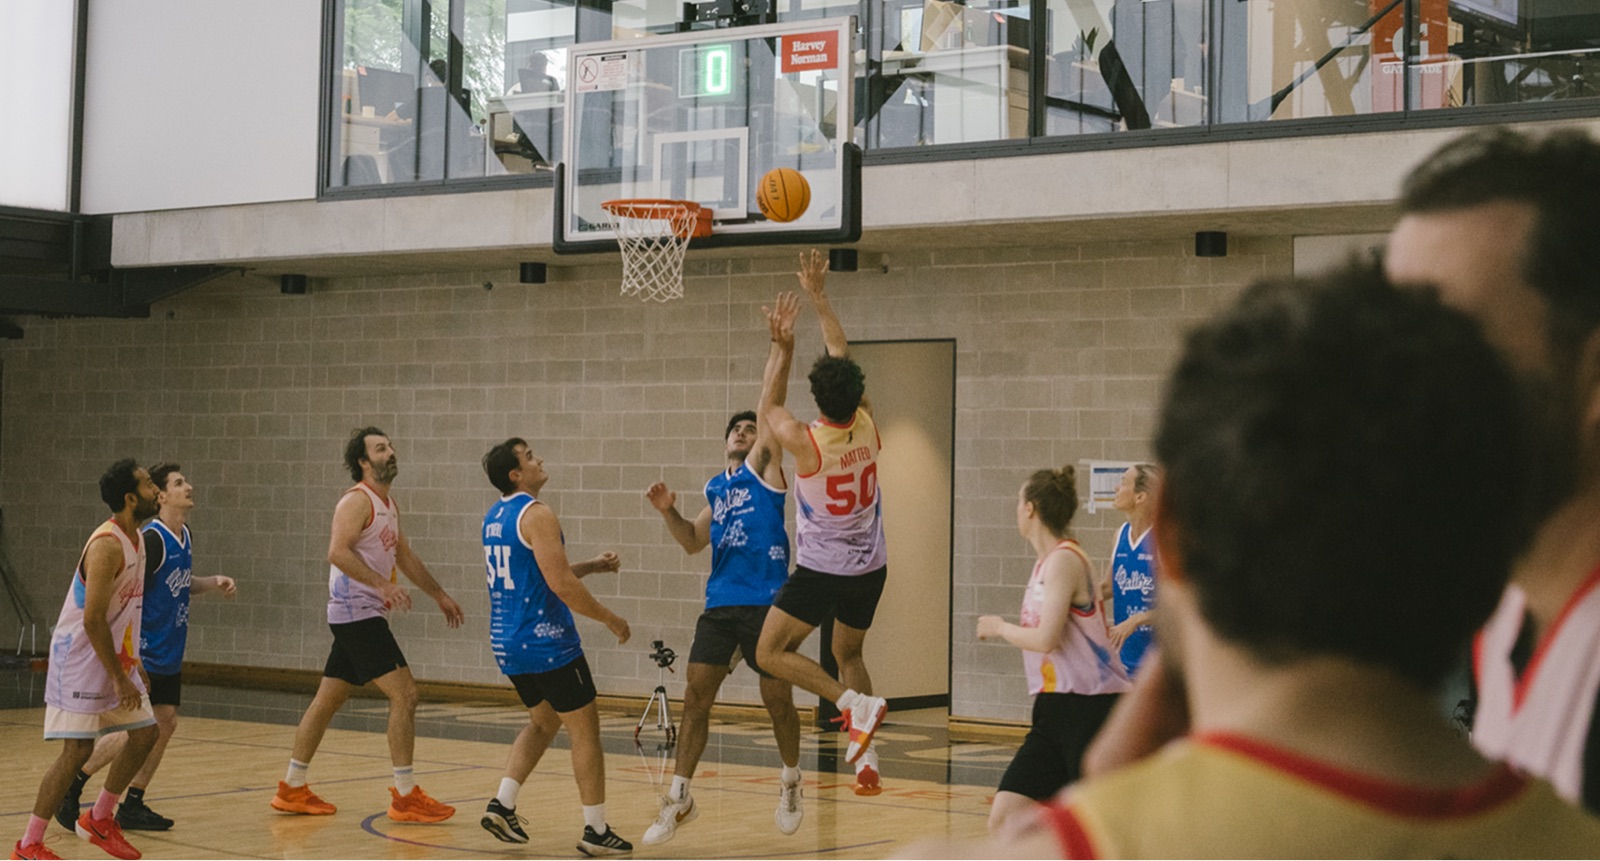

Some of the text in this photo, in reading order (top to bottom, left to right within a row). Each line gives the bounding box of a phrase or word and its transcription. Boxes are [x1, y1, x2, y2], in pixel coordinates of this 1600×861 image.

[792, 40, 827, 52] Harvey
[705, 49, 728, 92] 0
[790, 53, 828, 65] Norman
[840, 446, 871, 470] MATTEO
[825, 461, 877, 515] 50
